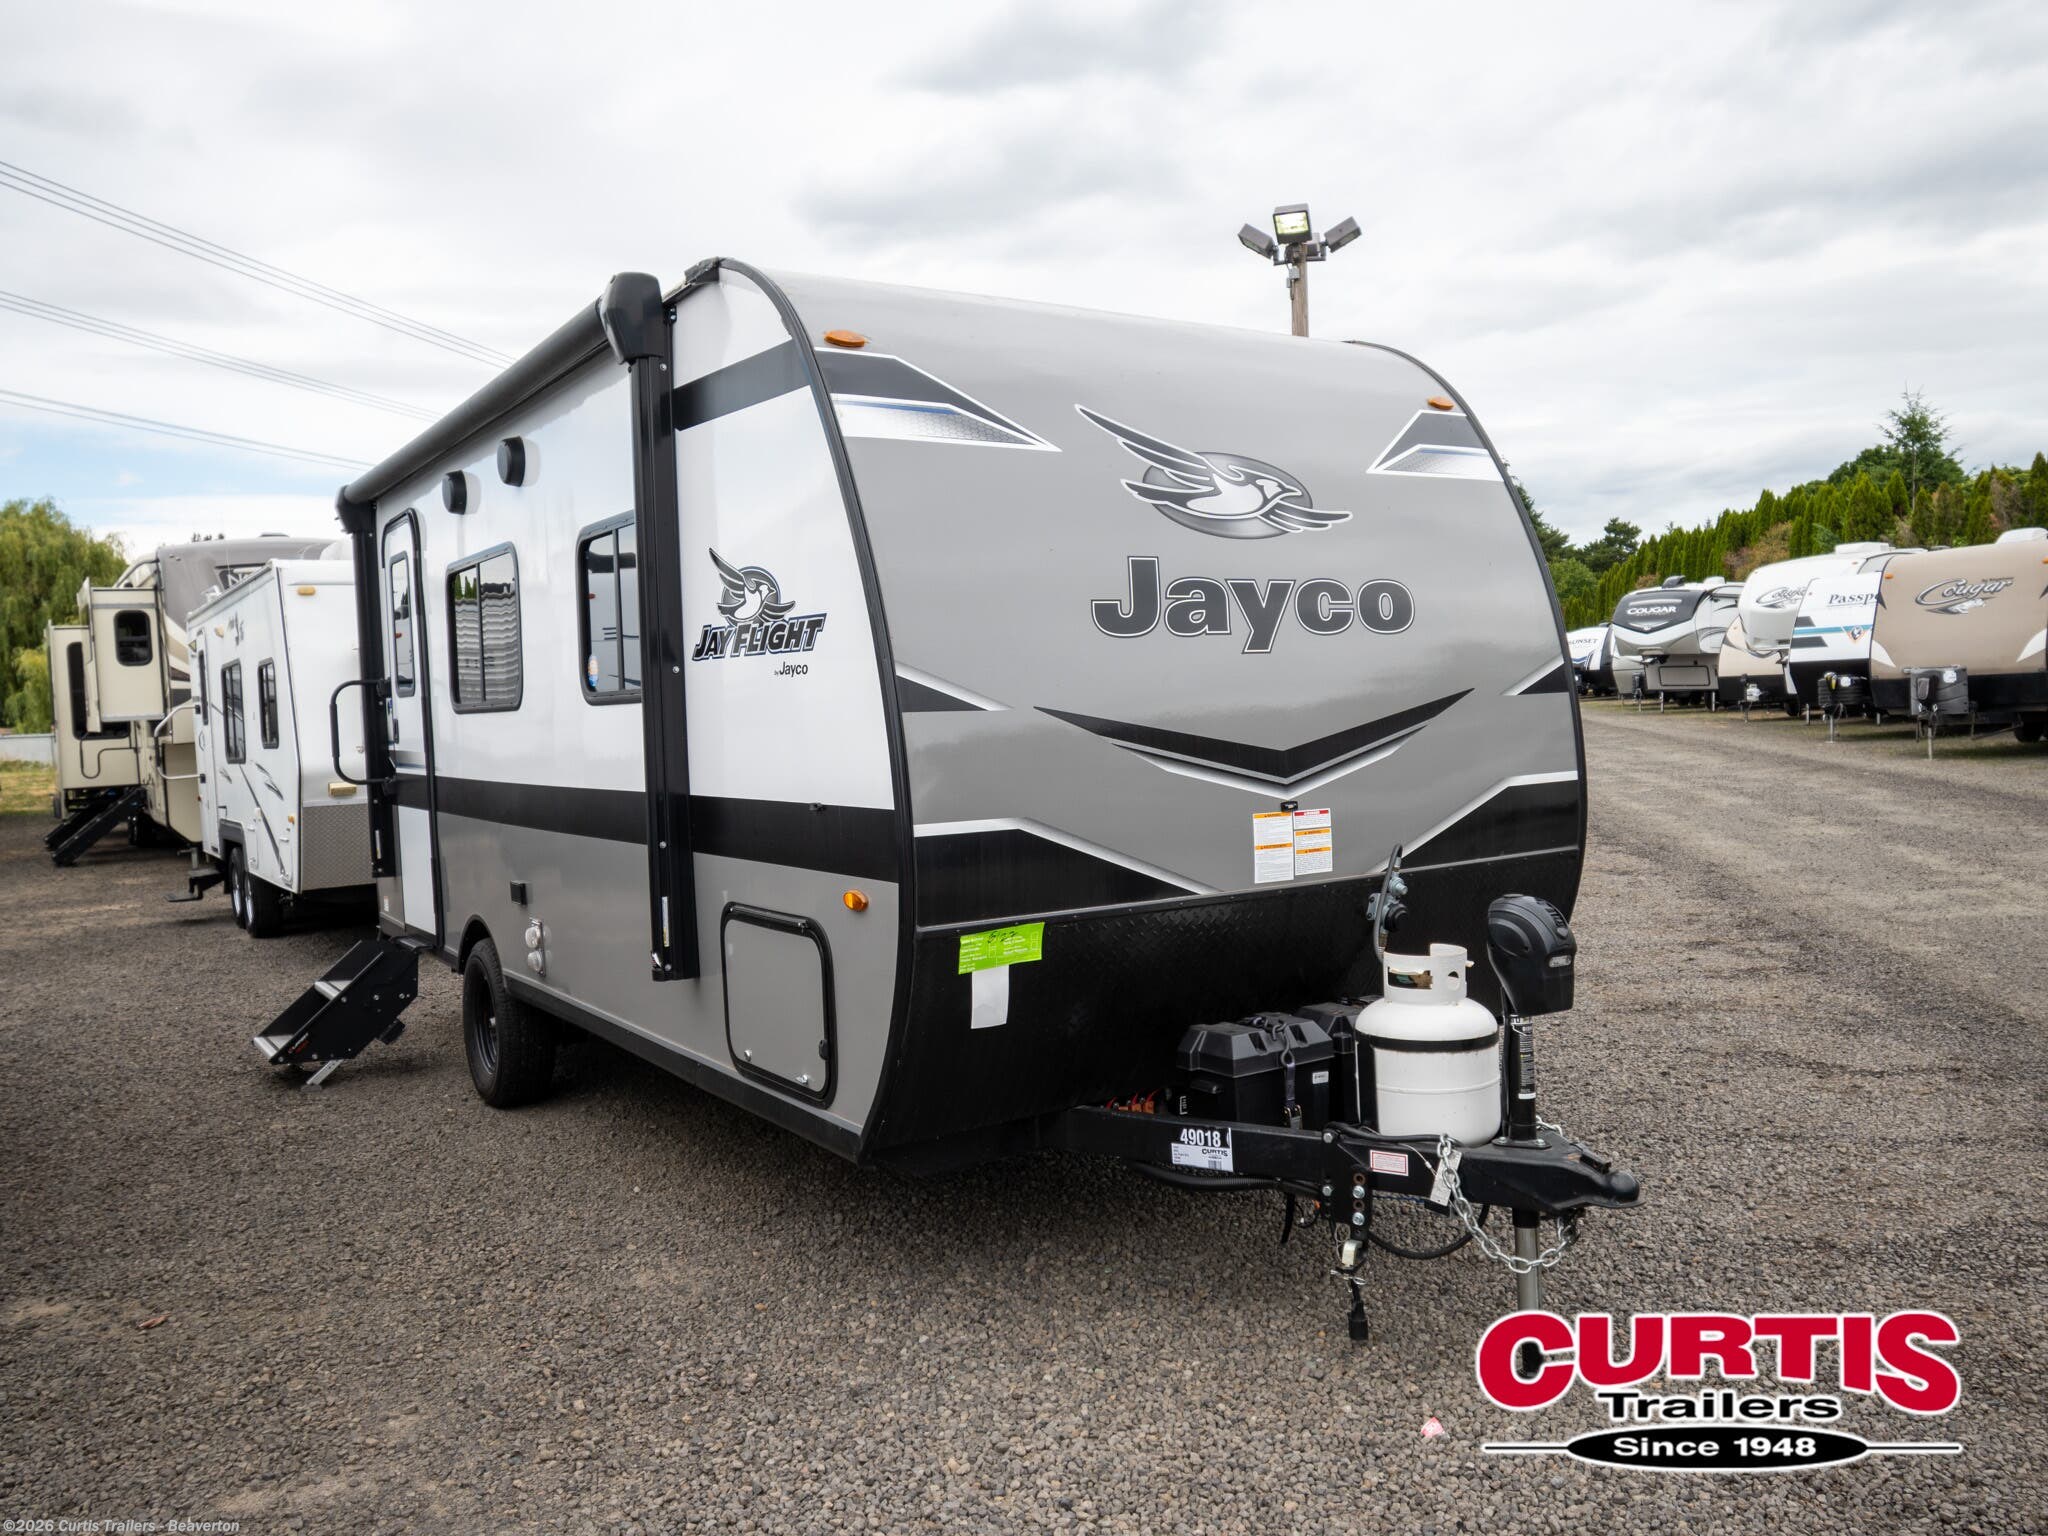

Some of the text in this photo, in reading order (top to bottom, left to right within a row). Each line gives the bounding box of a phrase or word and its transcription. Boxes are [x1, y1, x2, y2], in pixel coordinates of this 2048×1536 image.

[1915, 578, 2014, 605] Cougar
[1091, 556, 1415, 654] Jayco
[1627, 606, 1677, 615] COUGAR
[692, 613, 827, 661] JAY FLIGHT
[780, 661, 808, 677] Jayco
[1180, 1128, 1221, 1148] 49018
[1202, 1148, 1228, 1157] CURTIS
